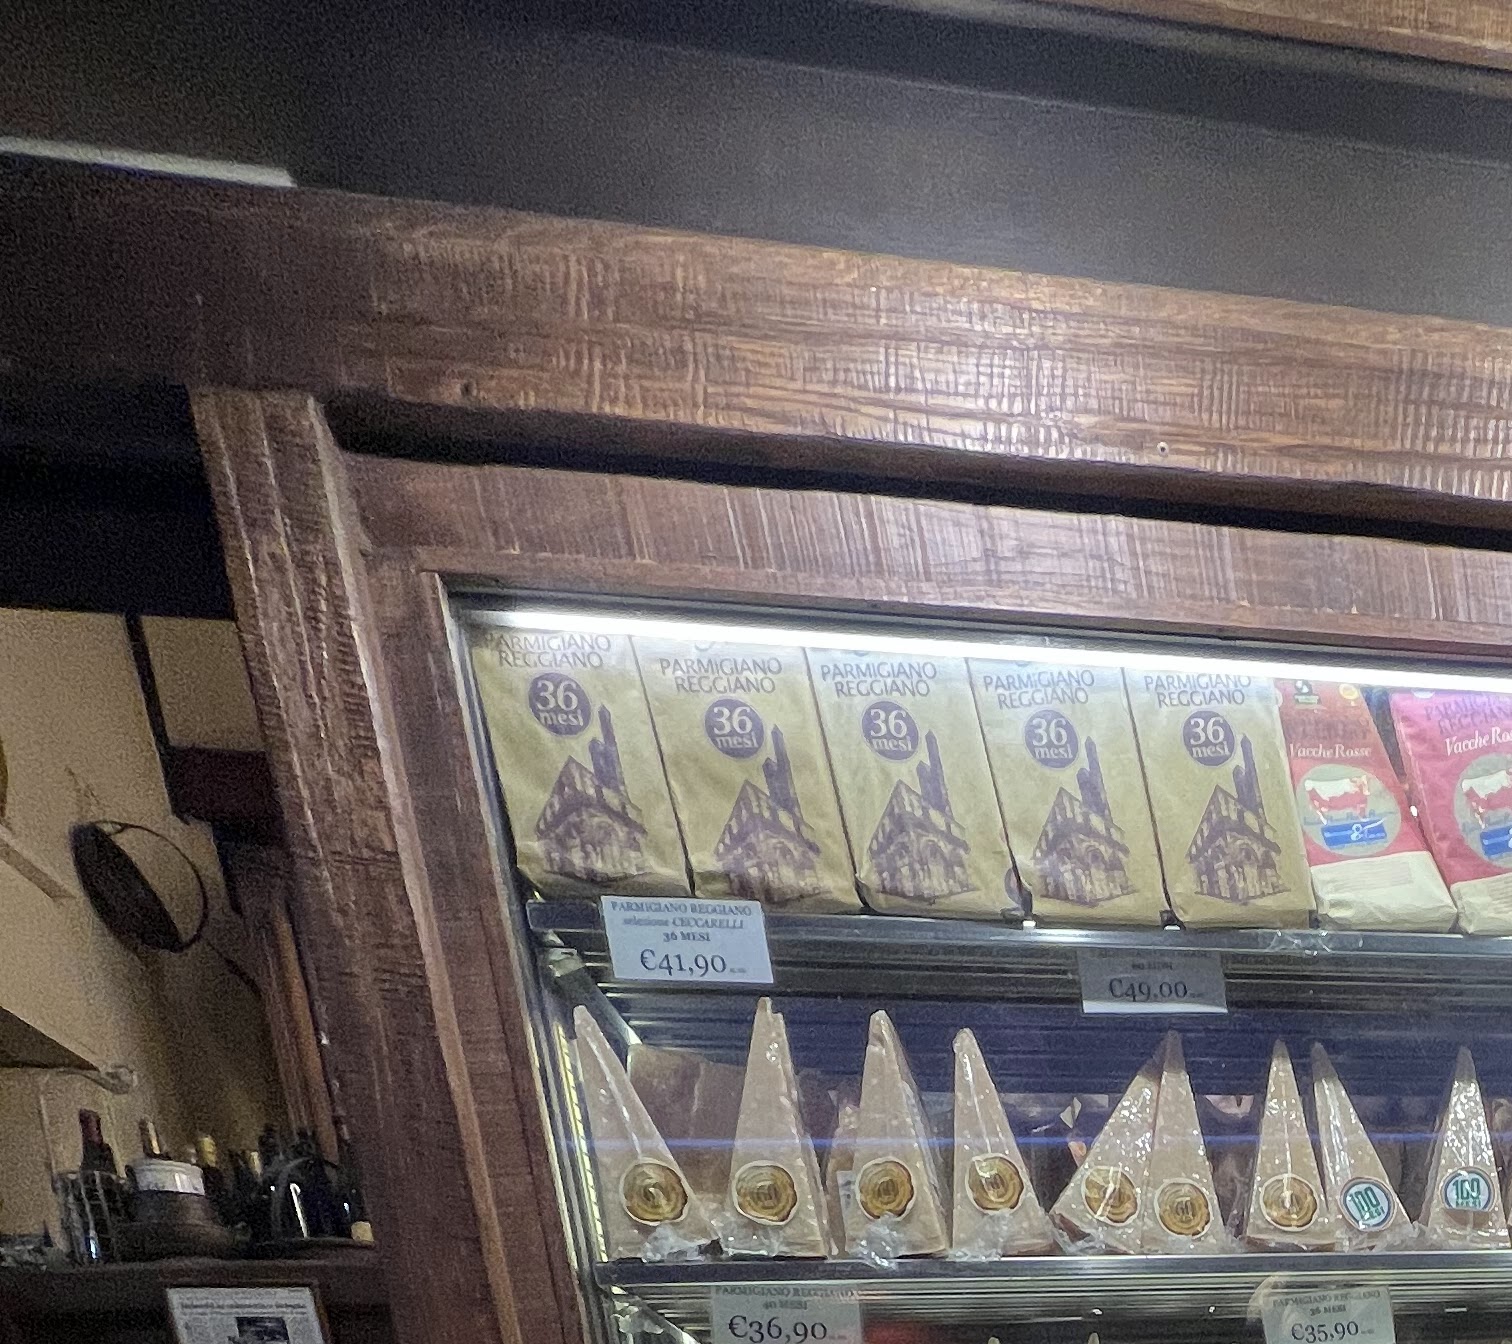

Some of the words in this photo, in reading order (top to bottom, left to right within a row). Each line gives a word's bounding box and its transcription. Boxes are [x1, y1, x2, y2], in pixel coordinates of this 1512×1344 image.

[660, 657, 783, 676] PARMIGIANO
[821, 662, 937, 681] PARMIGIANO
[675, 676, 776, 694] REGGIANO
[834, 680, 930, 698] REGGIANO
[983, 669, 1095, 693] PARMIGIANO
[1144, 673, 1251, 691] PARMIGIANO
[537, 680, 579, 712] 36
[997, 687, 1089, 710] REGGIANO
[1157, 689, 1245, 708] REGGIANO
[538, 710, 584, 727] mesi
[713, 706, 753, 735] 36
[870, 709, 908, 738] 36
[1032, 717, 1068, 747] 36
[1189, 716, 1225, 745] 36
[716, 734, 758, 749] mesi
[873, 737, 912, 752] mesi
[1192, 742, 1229, 758] mesi
[1335, 743, 1372, 758] Rosse
[1445, 731, 1489, 757] Vacche
[1034, 744, 1072, 760] mesi
[611, 901, 688, 914] PARMIGIANO
[690, 903, 752, 916] REGGIANO
[672, 917, 744, 929] CECCARELLI
[663, 931, 678, 942] 36
[681, 931, 711, 942] MESI
[640, 949, 727, 977] €41,90
[1349, 1186, 1381, 1212] 100
[715, 1285, 790, 1297] PARMIGIANO
[728, 1315, 828, 1344] €36,90
[1291, 1320, 1359, 1344] €35,90
